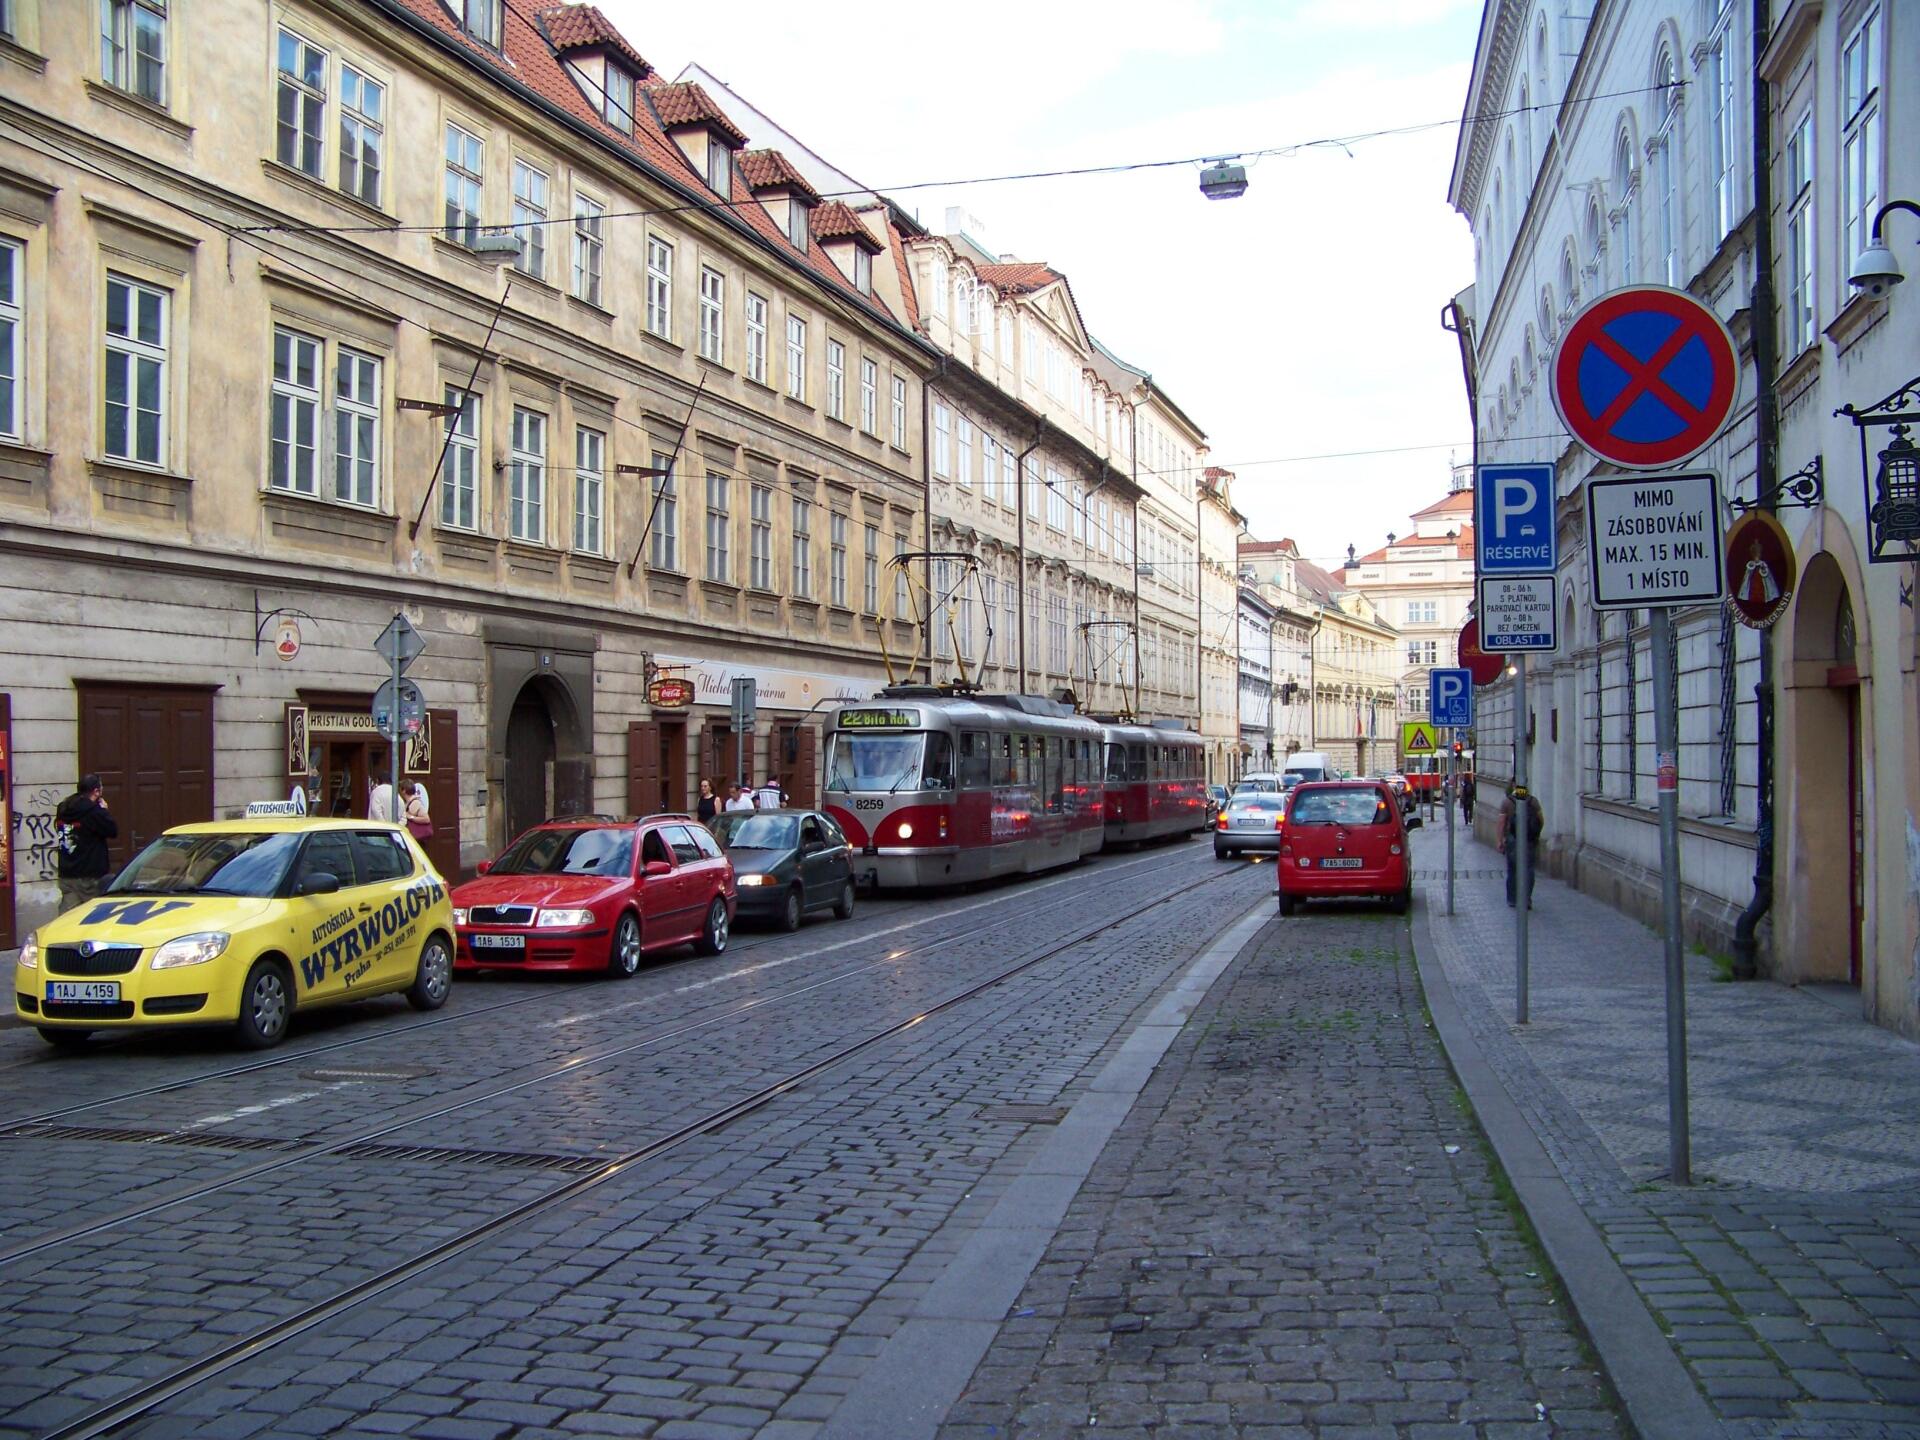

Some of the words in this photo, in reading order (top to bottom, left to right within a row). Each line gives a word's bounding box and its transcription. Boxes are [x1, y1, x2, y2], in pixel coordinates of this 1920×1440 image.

[1634, 489, 1674, 508] MIMO
[1495, 479, 1537, 538] P
[1608, 510, 1704, 537] ZÁSOBOVÁNÍ
[1485, 543, 1550, 560] RÉSERVÉ
[1605, 546, 1644, 564] MAX.
[1650, 544, 1667, 561] 15
[1674, 542, 1709, 561] MIN.
[1628, 573, 1634, 590] 1
[1641, 568, 1690, 590] MÍSTO
[1517, 584, 1526, 592] 06
[1527, 584, 1532, 592] h
[1500, 594, 1505, 603] S
[1508, 594, 1537, 603] PLATNOU
[1525, 603, 1551, 612] KARTOU
[1752, 591, 1792, 629] PRAGENSIS
[1503, 614, 1512, 623] 06
[1497, 624, 1510, 633] BEZ
[1495, 635, 1534, 645] OBLAST
[1539, 634, 1544, 644] 1
[754, 683, 787, 699] avárna
[1440, 676, 1463, 709] P
[308, 715, 351, 727] HRISTIAN
[843, 710, 864, 726] 22
[856, 799, 884, 810] 8259
[311, 906, 356, 945] AUTOŠKOLA
[477, 936, 493, 947] 1AB
[500, 936, 521, 947] 1531
[344, 959, 371, 989] Praha
[57, 984, 76, 998] 1AJ
[85, 984, 114, 998] 4159
